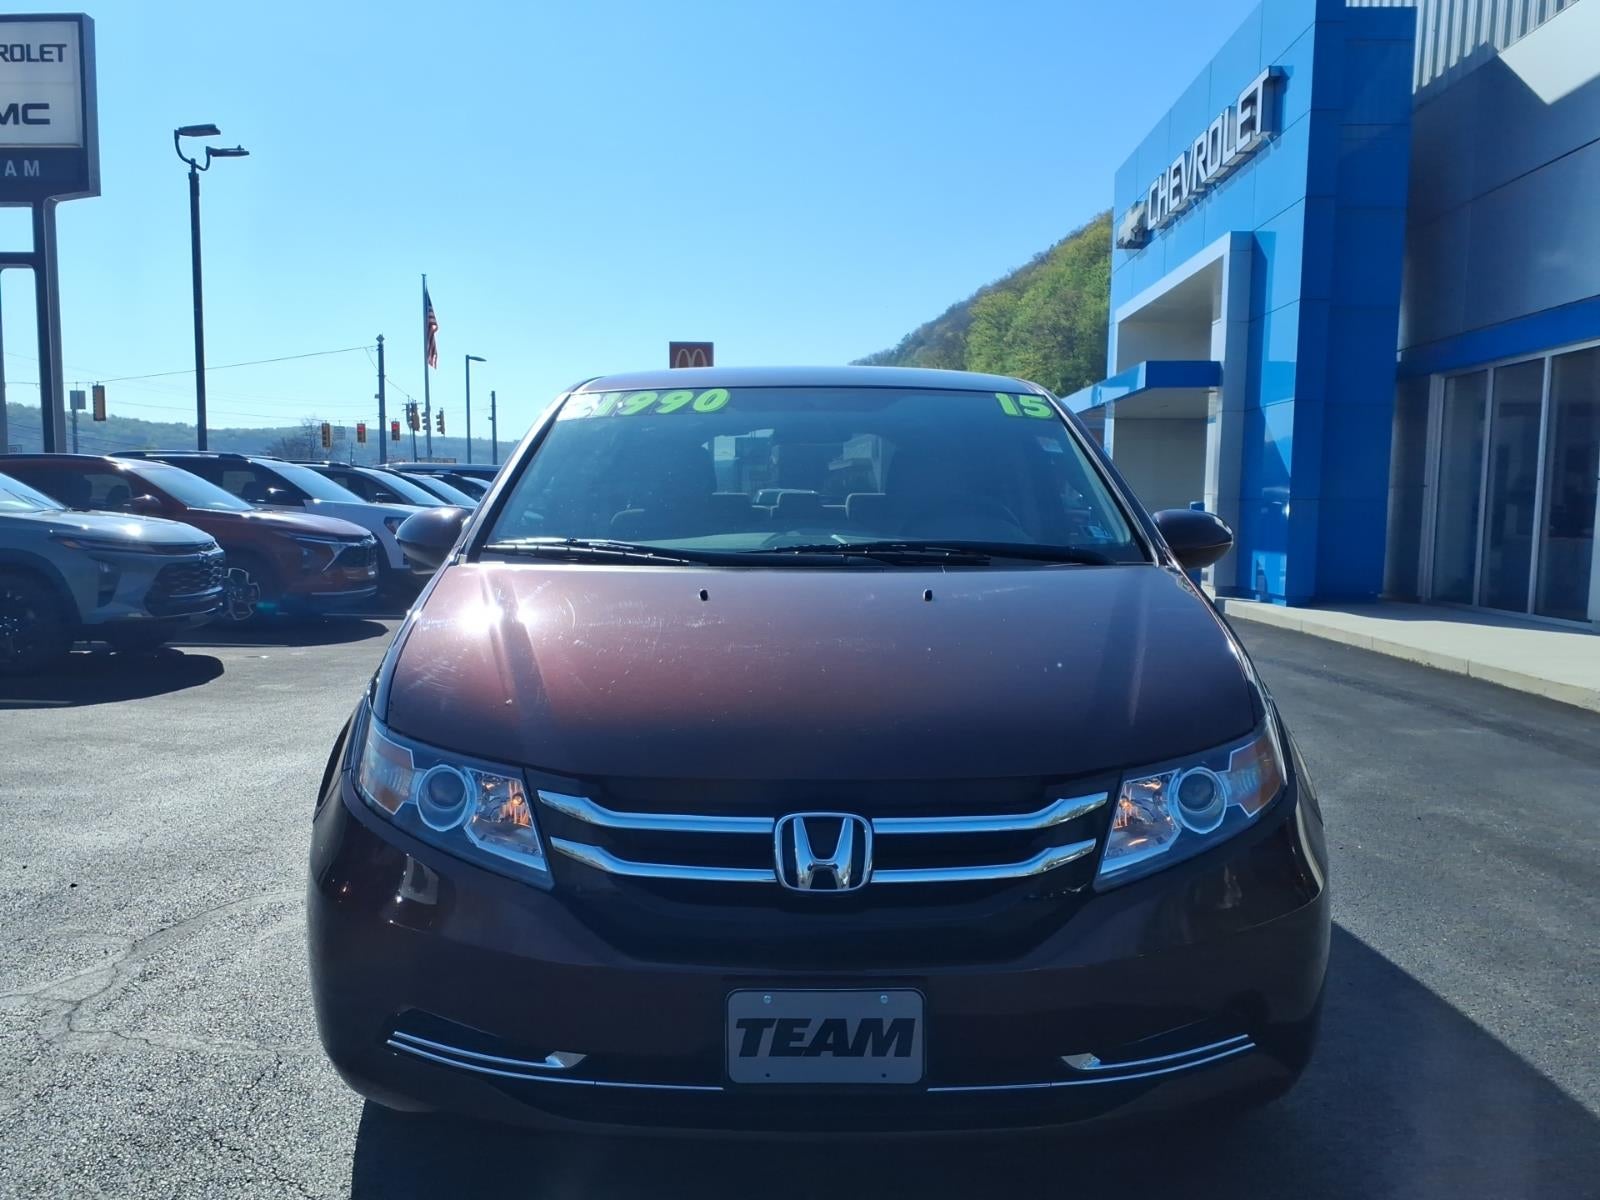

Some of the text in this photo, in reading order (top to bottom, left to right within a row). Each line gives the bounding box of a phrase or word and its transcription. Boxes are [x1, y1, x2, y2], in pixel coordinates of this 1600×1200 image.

[1147, 66, 1270, 230] CHEVROLET
[5, 160, 40, 177] AM
[557, 388, 730, 421] 1990
[995, 392, 1053, 418] 15
[736, 1018, 915, 1057] TEAM
